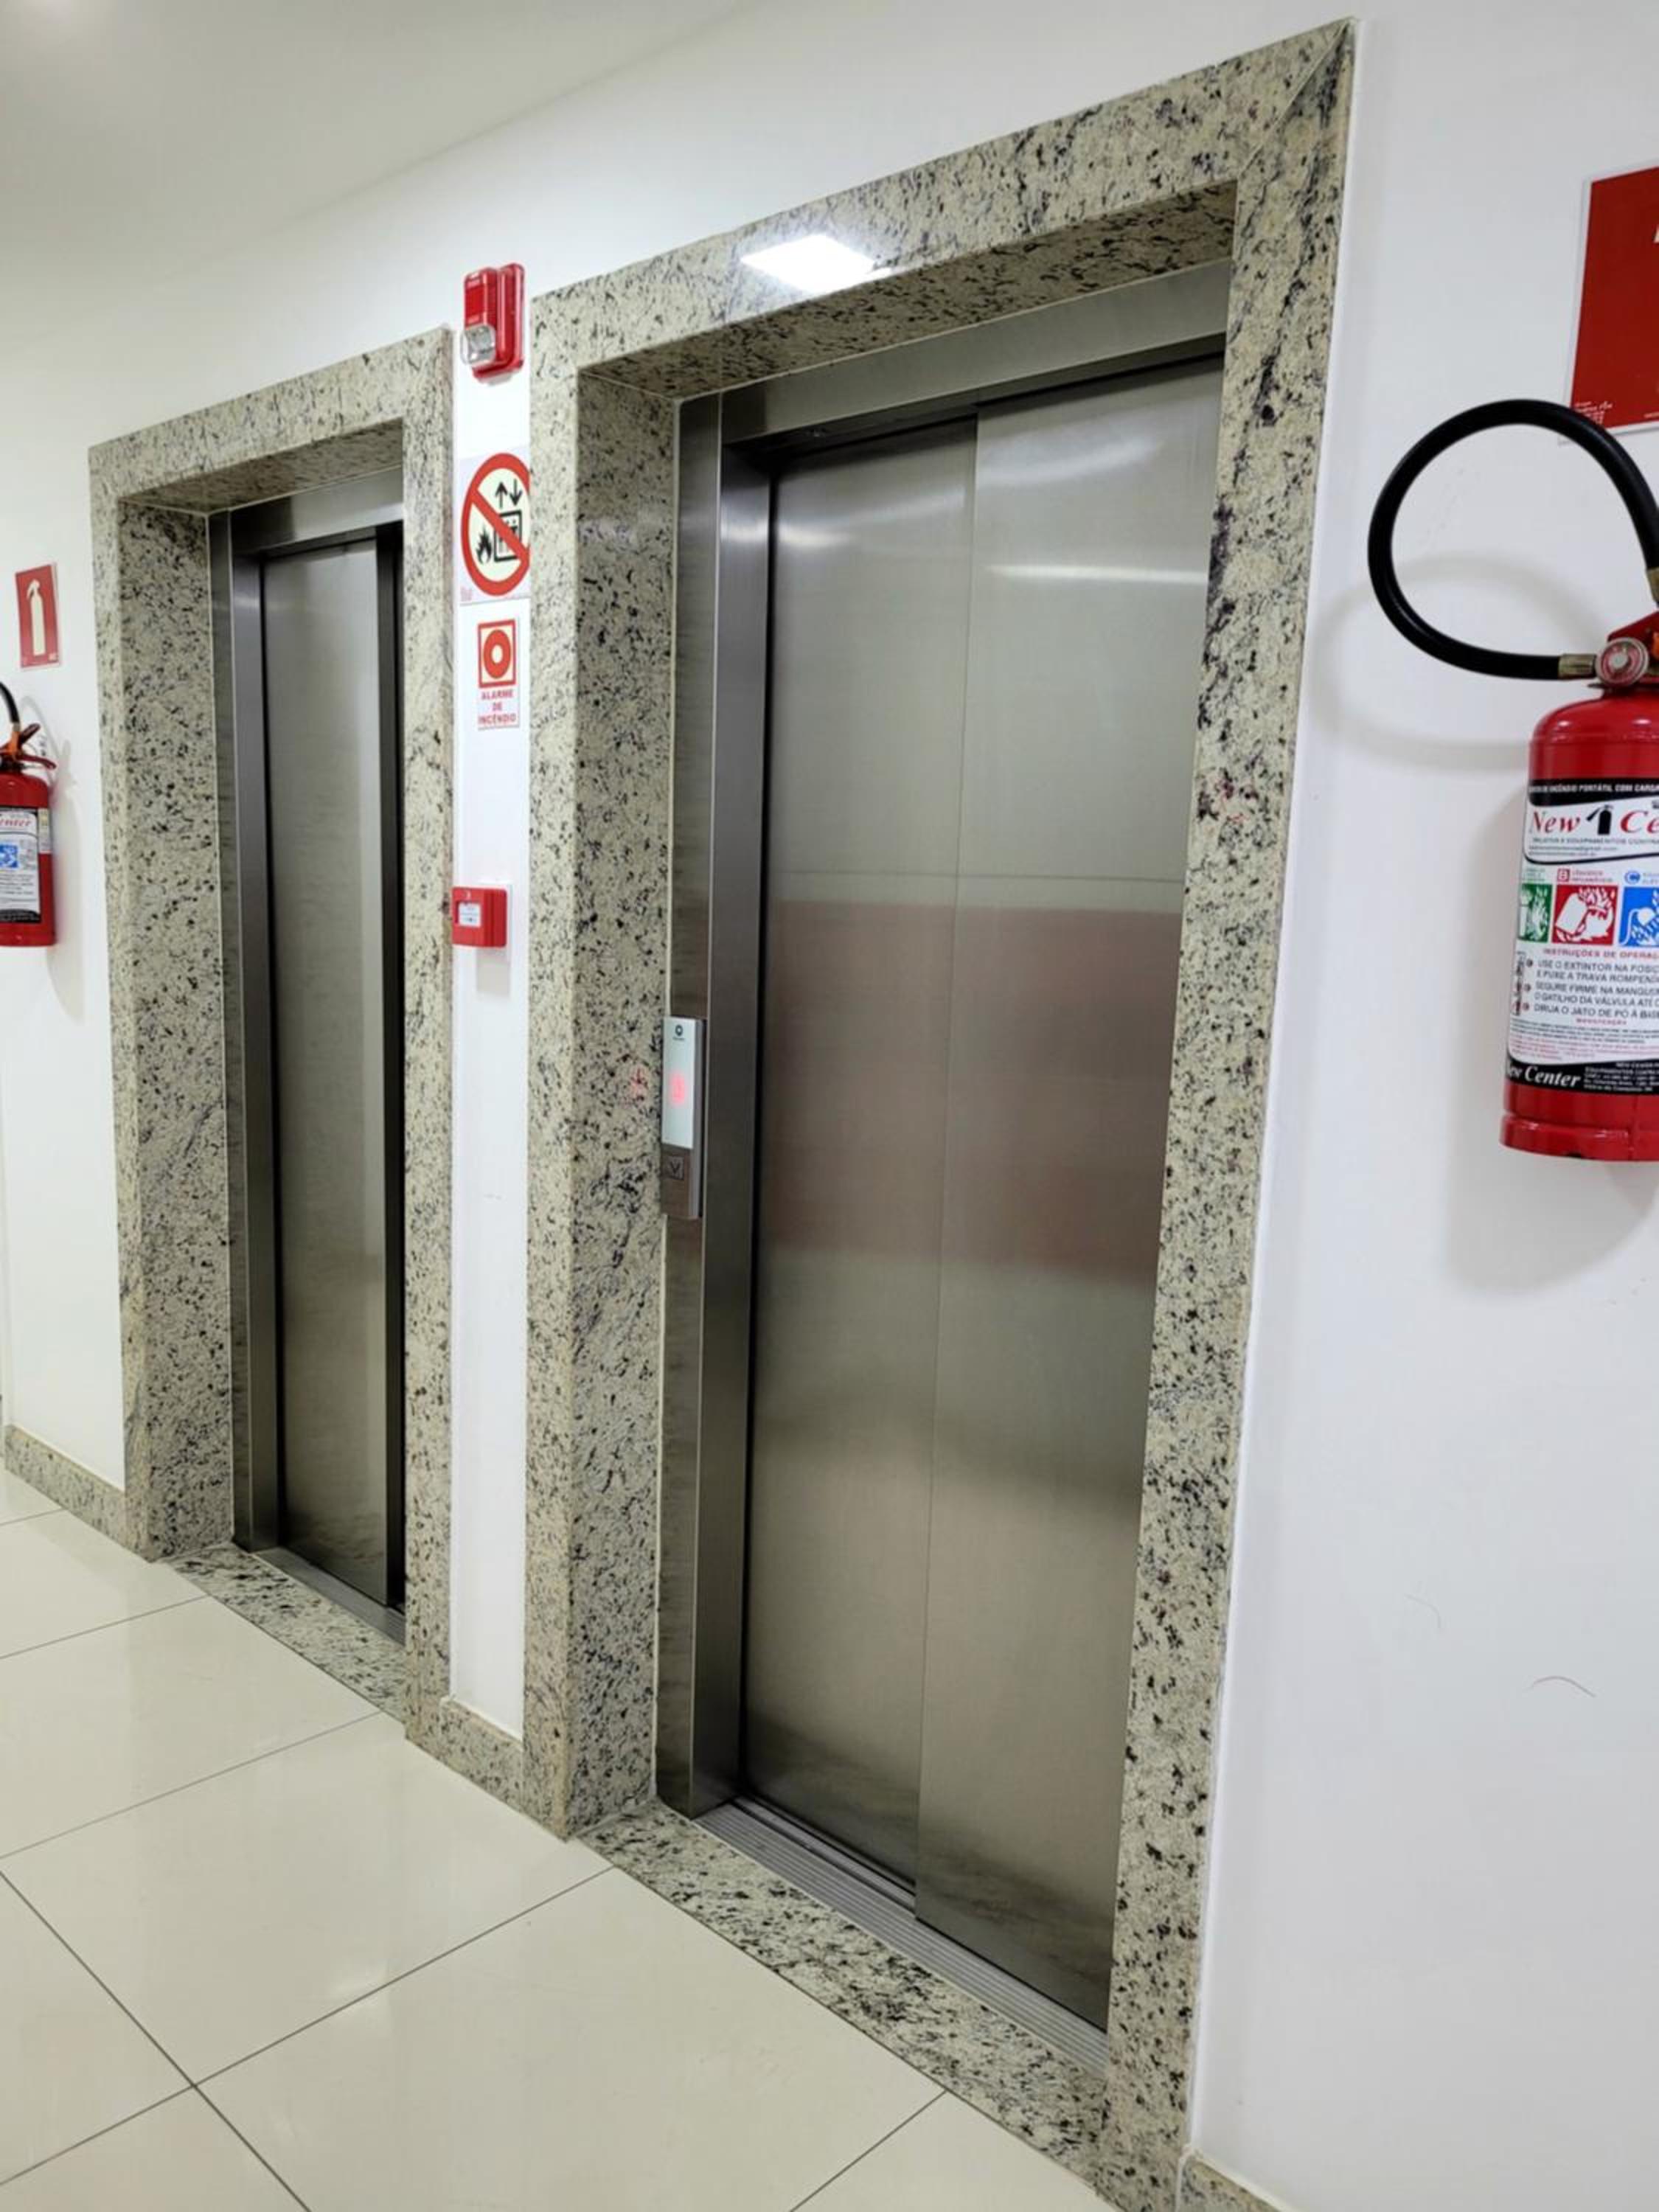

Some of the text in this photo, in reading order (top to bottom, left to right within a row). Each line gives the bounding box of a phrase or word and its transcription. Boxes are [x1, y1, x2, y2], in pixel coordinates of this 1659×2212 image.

[481, 689, 512, 700] ALARME
[493, 701, 502, 711] DE
[1530, 810, 1580, 834] New
[1565, 960, 1612, 971] EXTINTOR
[1615, 962, 1628, 971] NA
[1576, 972, 1607, 982] TRAVA
[1600, 985, 1613, 994] NA
[1561, 1005, 1569, 1014] O
[1571, 1006, 1596, 1016] JATO
[1599, 1007, 1612, 1017] DE
[1524, 1065, 1582, 1088] Center
